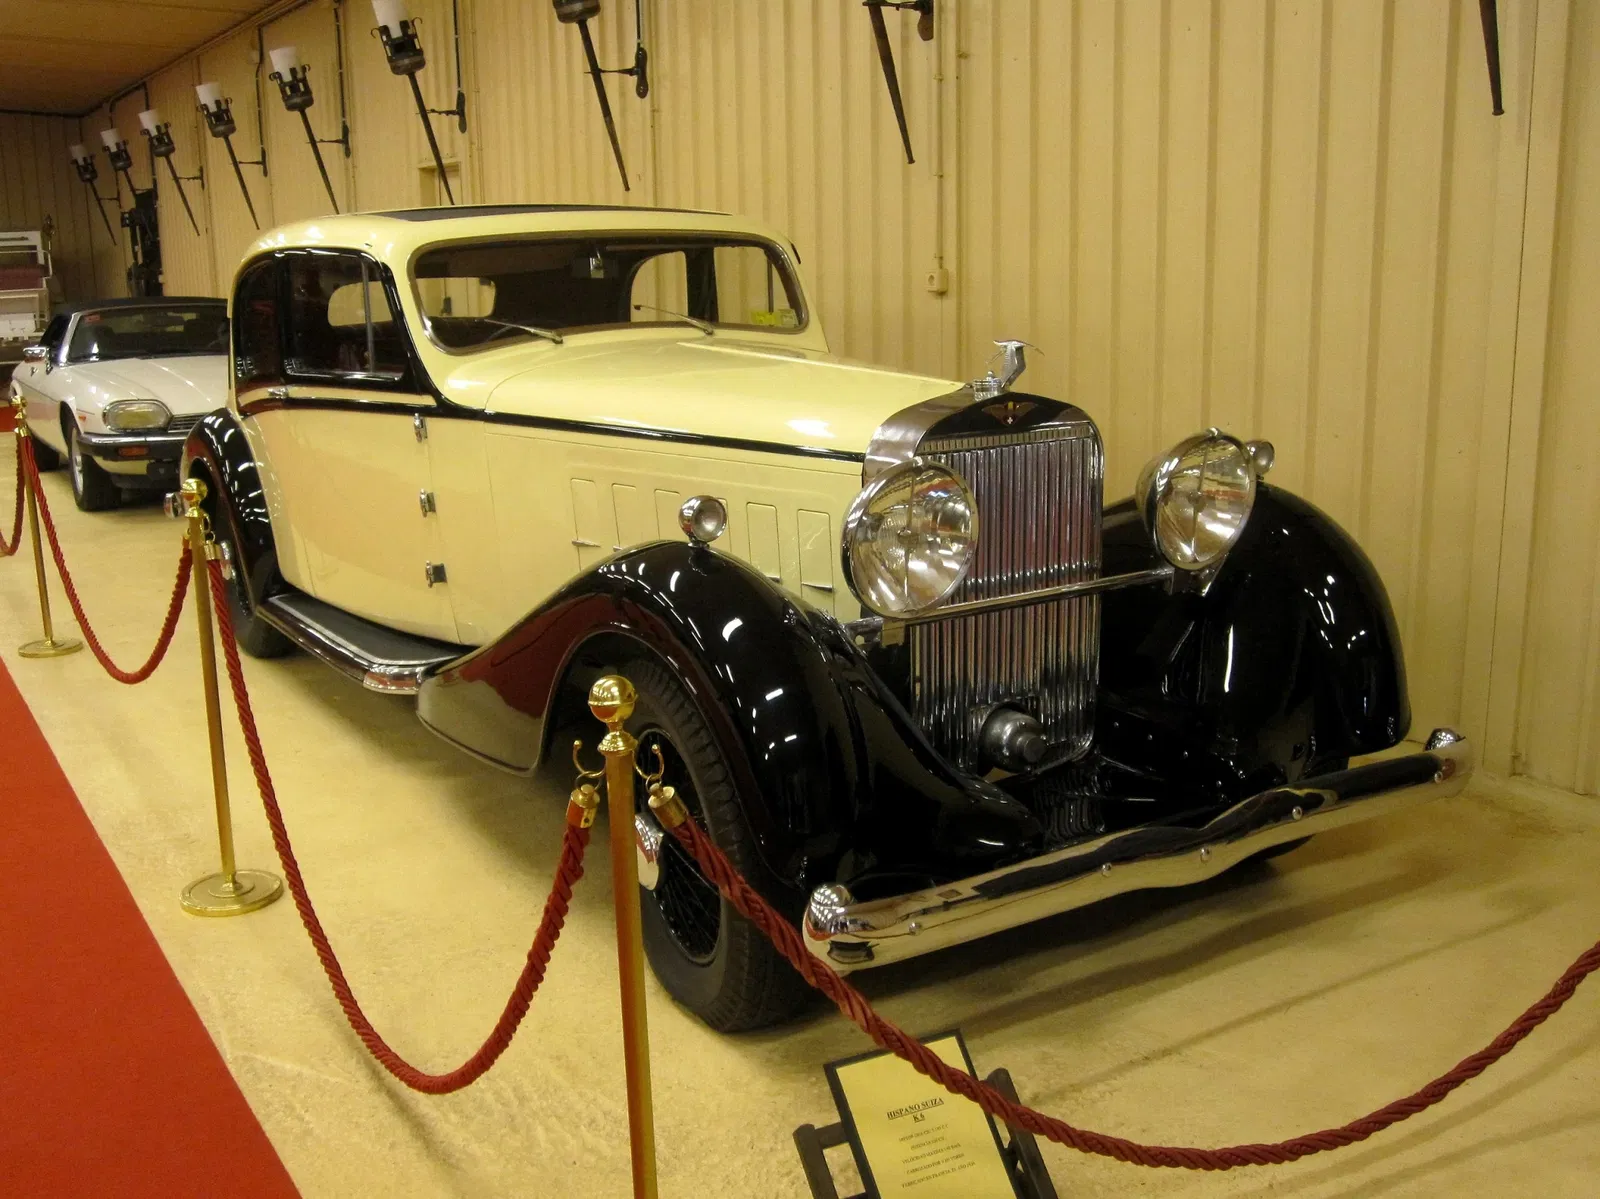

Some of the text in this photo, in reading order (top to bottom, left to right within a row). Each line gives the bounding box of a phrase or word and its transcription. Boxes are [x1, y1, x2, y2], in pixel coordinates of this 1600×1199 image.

[887, 1097, 944, 1119] HISPANO SUIZA
[913, 1114, 919, 1122] K
